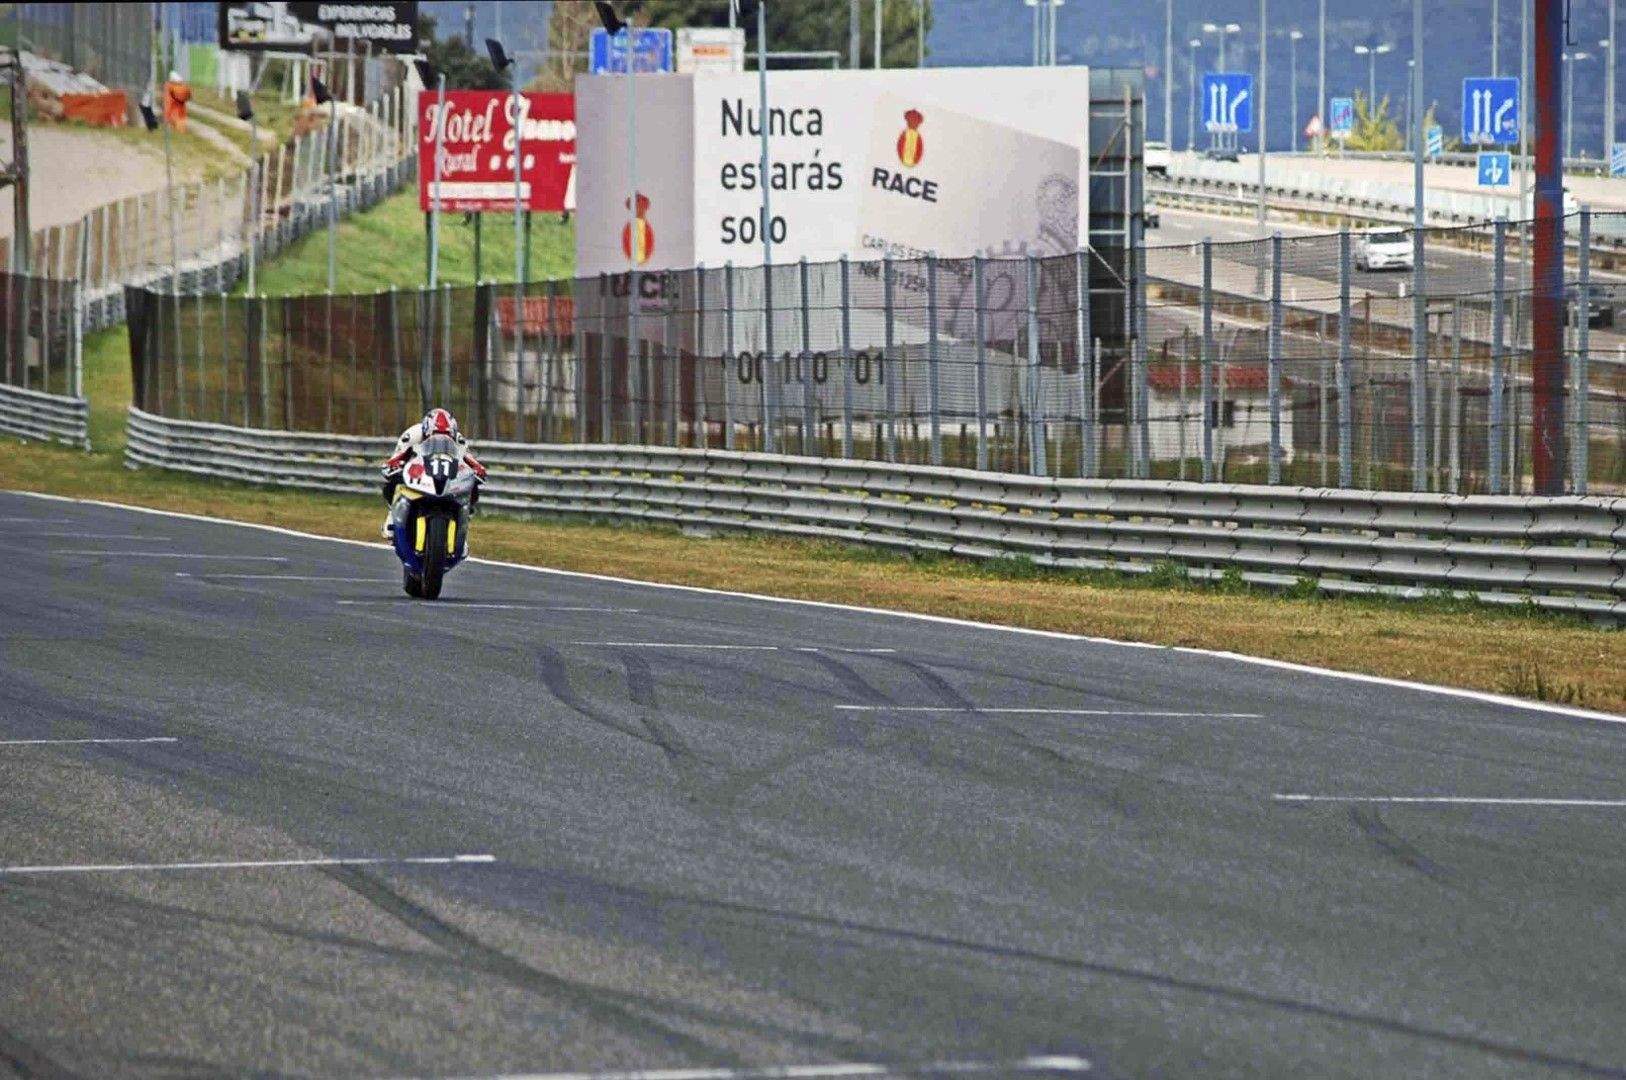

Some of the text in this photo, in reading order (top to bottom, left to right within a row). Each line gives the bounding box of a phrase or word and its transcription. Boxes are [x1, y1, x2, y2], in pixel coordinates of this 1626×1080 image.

[424, 98, 499, 143] Hotel
[720, 98, 822, 136] Nunca
[872, 167, 938, 202] RACE
[720, 207, 787, 244] solo
[430, 459, 450, 475] 11
